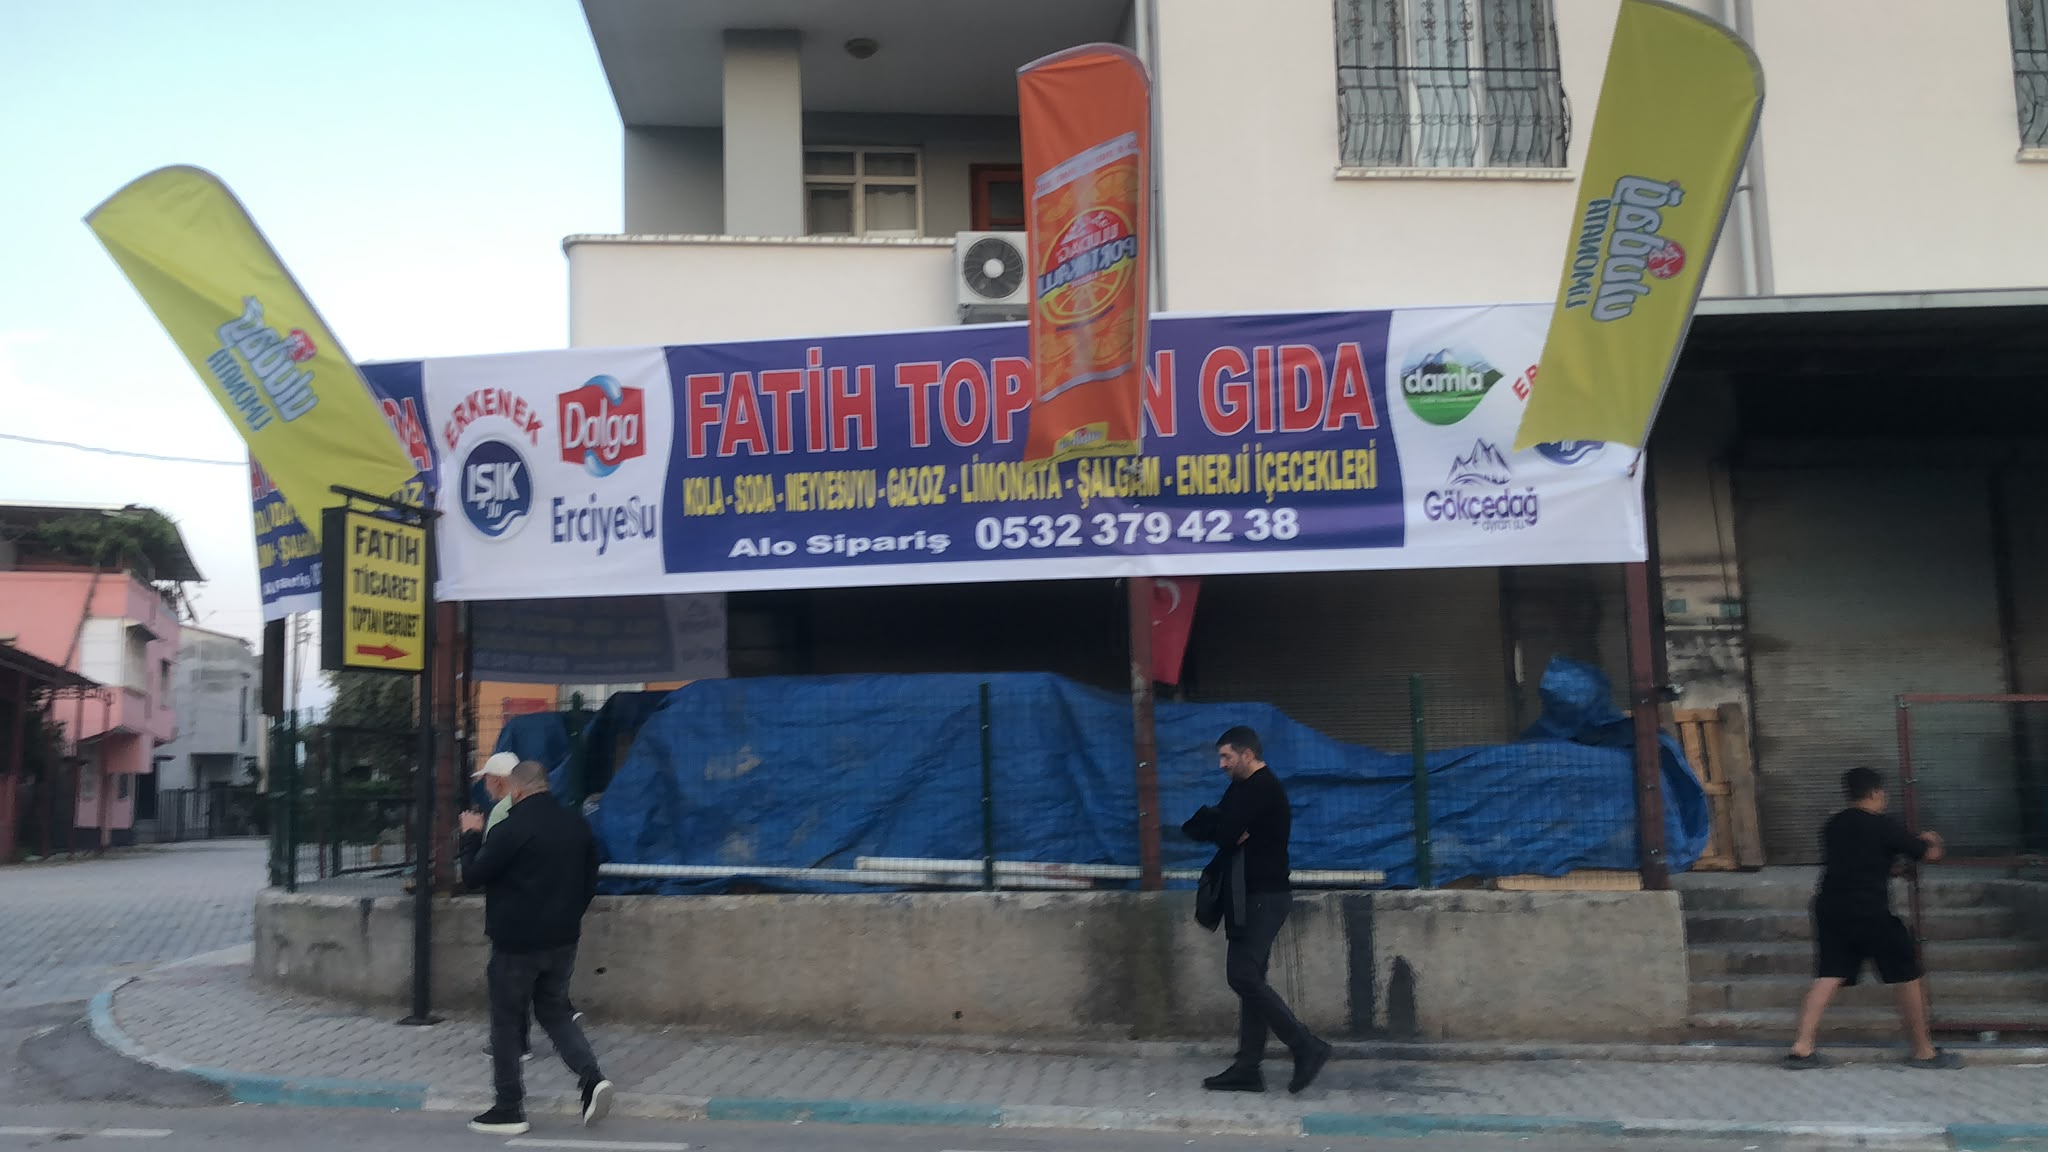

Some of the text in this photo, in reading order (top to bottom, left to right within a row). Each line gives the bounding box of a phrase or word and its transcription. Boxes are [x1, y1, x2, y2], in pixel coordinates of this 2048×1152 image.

[685, 342, 1380, 459] FATİH TOPN GIDA
[1405, 370, 1484, 393] damla
[444, 387, 544, 452] ERKENEK
[563, 398, 640, 461] Dalga
[682, 475, 725, 517] KOLA
[733, 473, 777, 515] SODA
[784, 468, 876, 512] MEYVESUYU
[886, 464, 946, 508] GAZOZ
[1176, 443, 1251, 496] ENERJİ
[1255, 438, 1379, 503] İÇECEKLERİ
[1423, 486, 1540, 527] Gökçedağ
[354, 523, 420, 566] FATİH
[728, 507, 1301, 558] Alo Sipariş 0532 379 42 38
[353, 562, 418, 602] TİCARET
